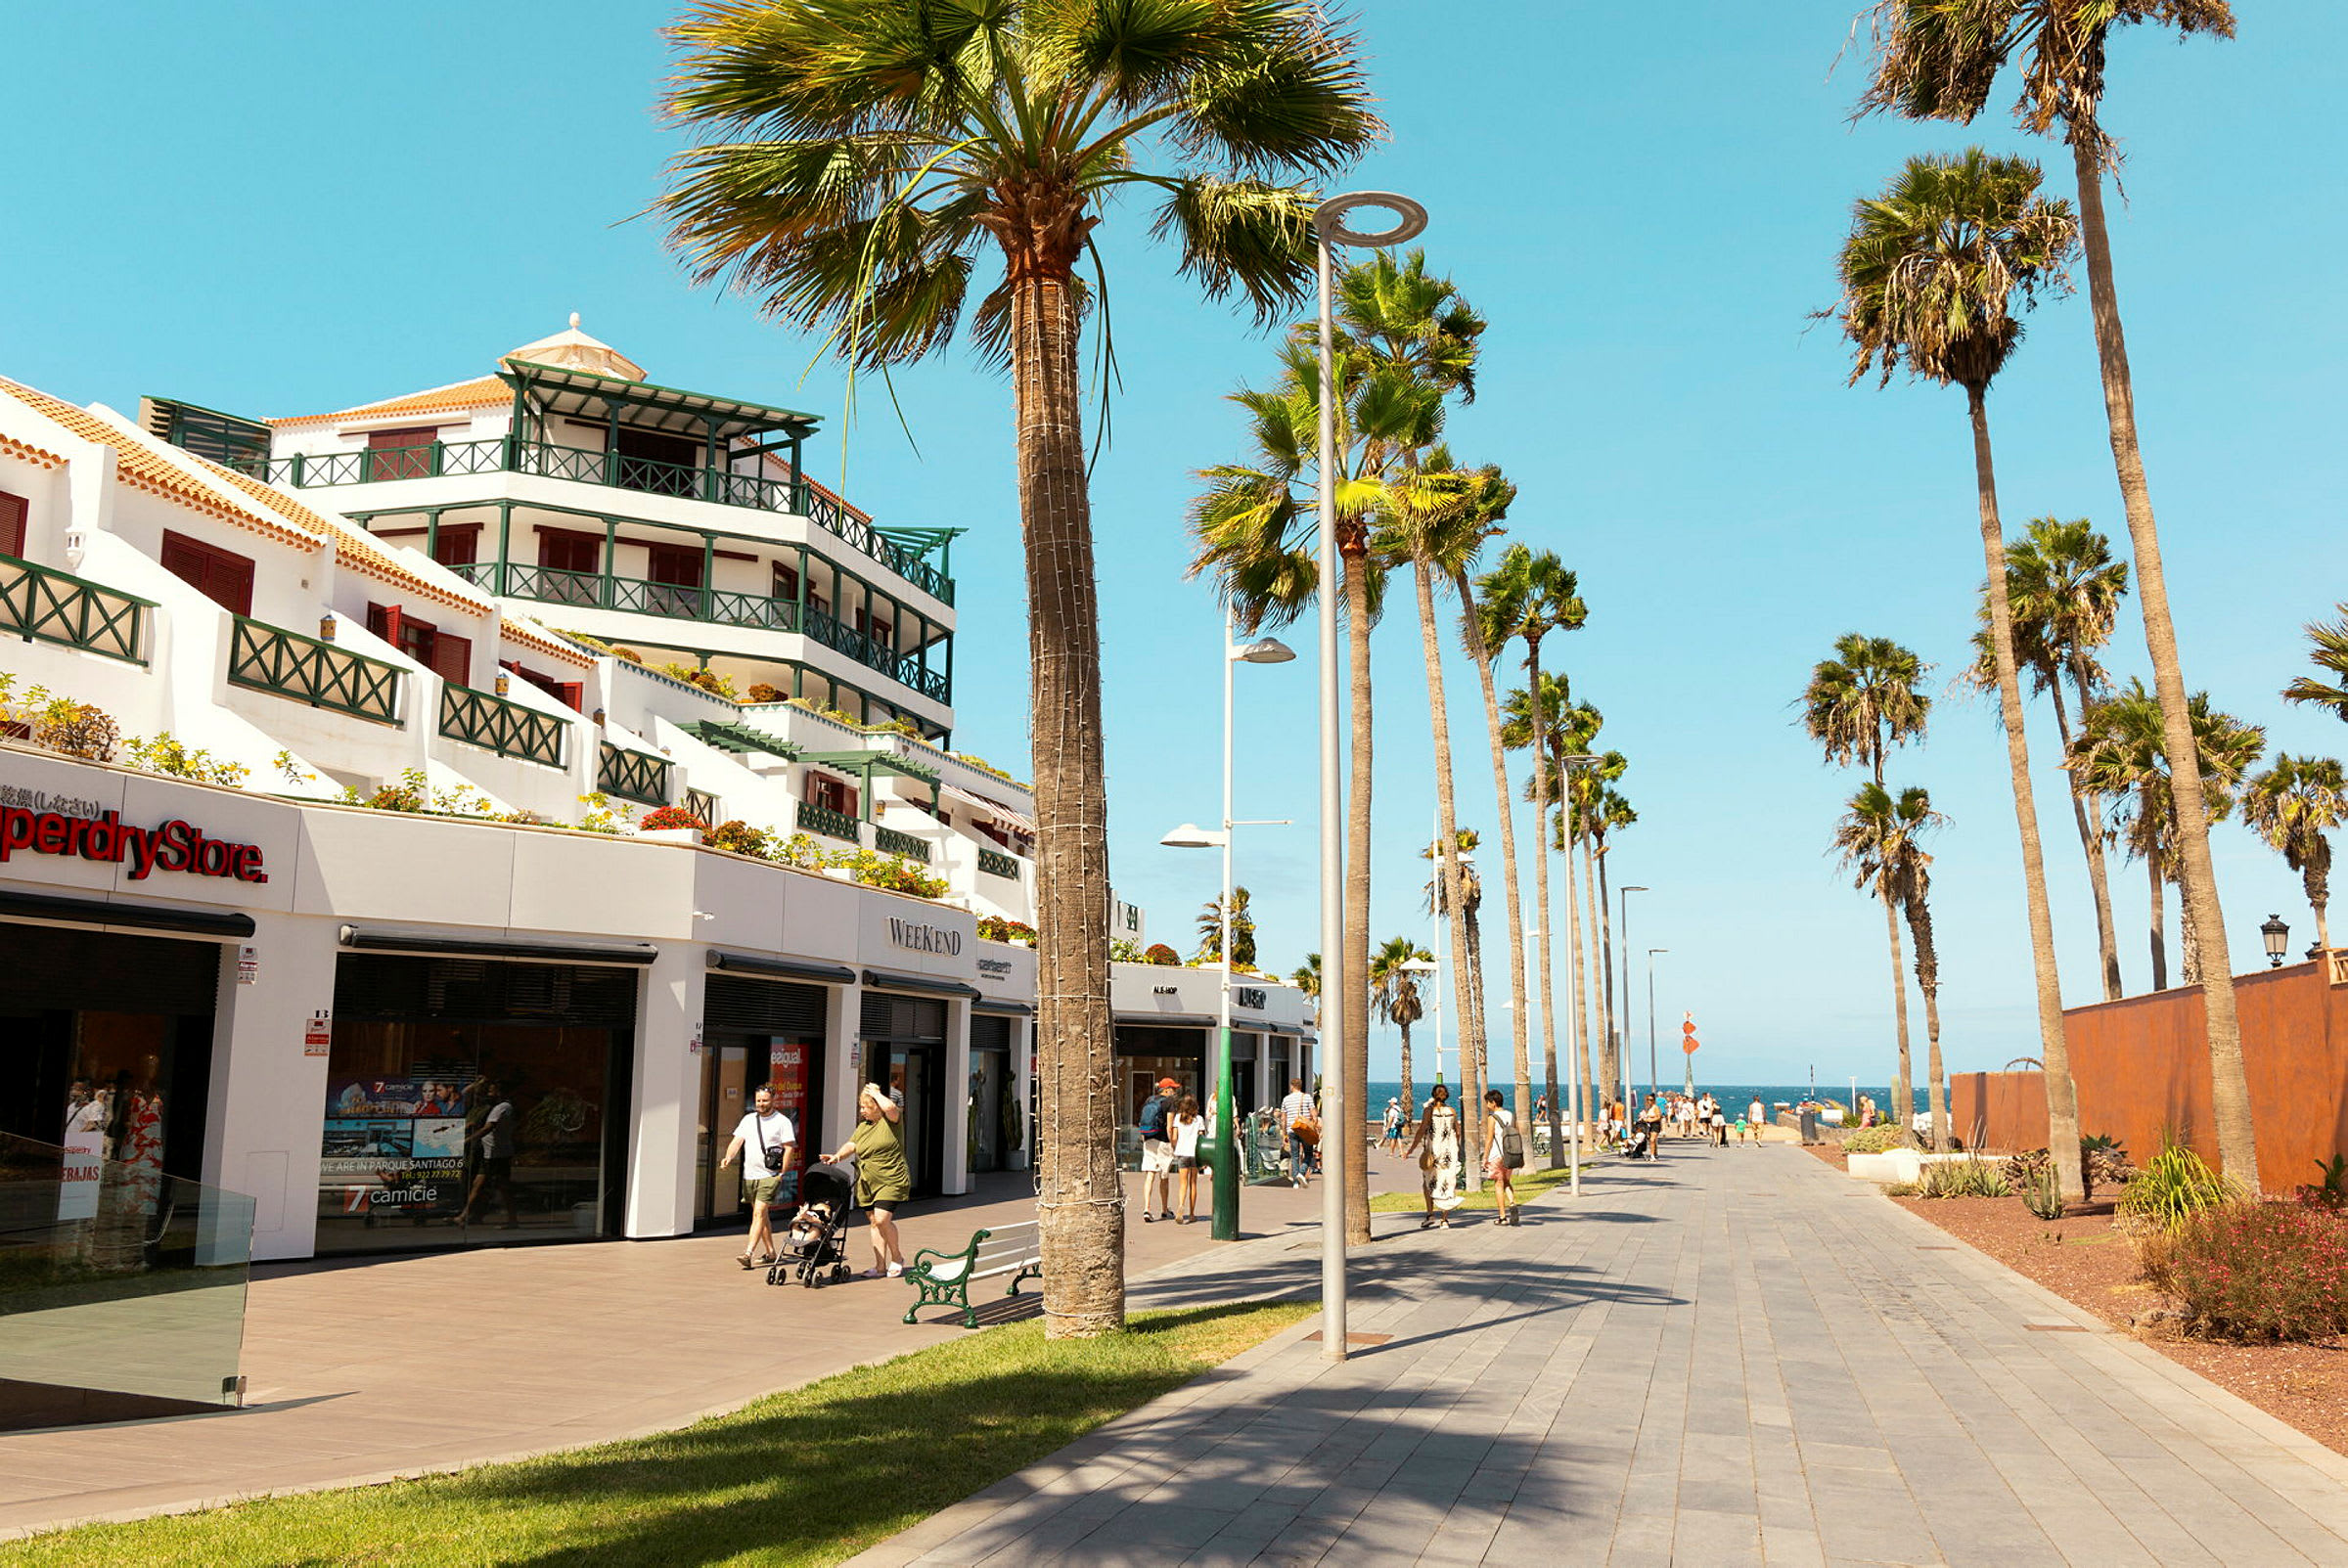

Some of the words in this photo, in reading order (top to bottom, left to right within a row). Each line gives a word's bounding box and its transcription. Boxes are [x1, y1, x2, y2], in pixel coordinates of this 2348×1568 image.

[315, 1009, 330, 1018] 13
[375, 1082, 384, 1093] 7
[336, 1161, 355, 1172] ARE
[356, 1160, 368, 1171] IN
[371, 1159, 408, 1171] PARQUE
[409, 1158, 456, 1170] SANTIAGO
[457, 1159, 464, 1169] 6
[347, 1185, 368, 1212] 7
[370, 1186, 438, 1203] camicie
